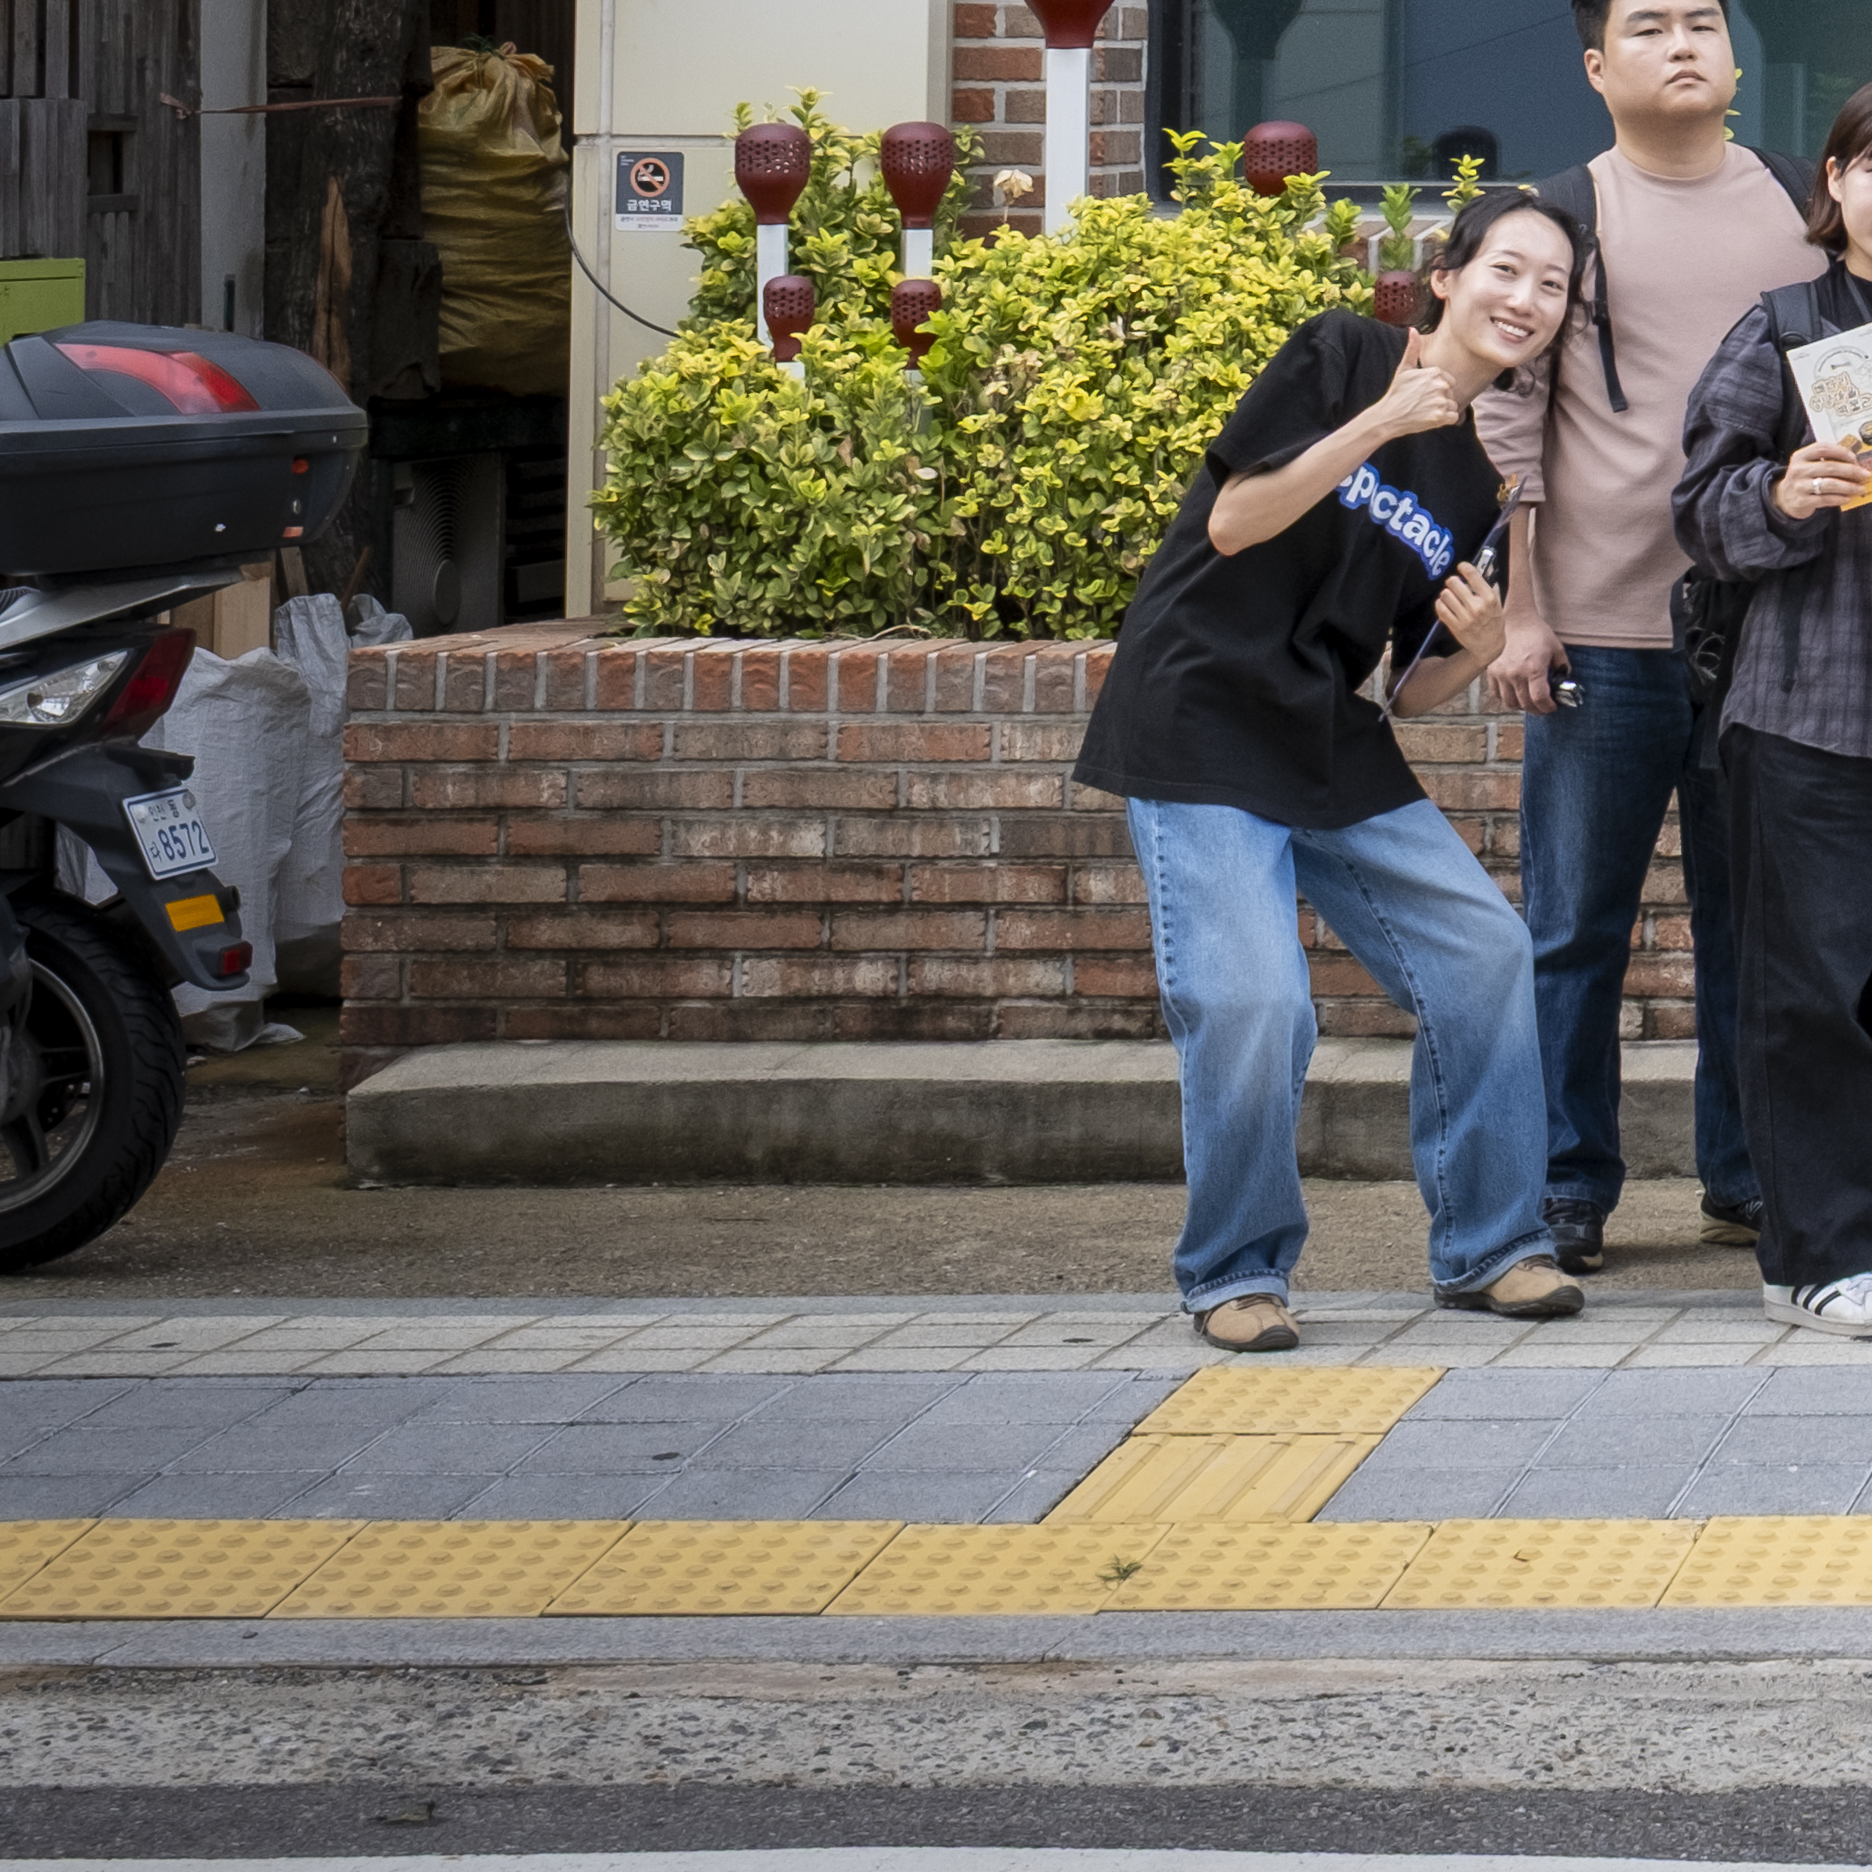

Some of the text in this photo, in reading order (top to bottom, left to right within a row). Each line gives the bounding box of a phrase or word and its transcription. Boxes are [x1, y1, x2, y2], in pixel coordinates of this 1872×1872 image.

[626, 199, 673, 212] 금연구역
[167, 799, 180, 819] 동
[157, 819, 210, 861] 8572
